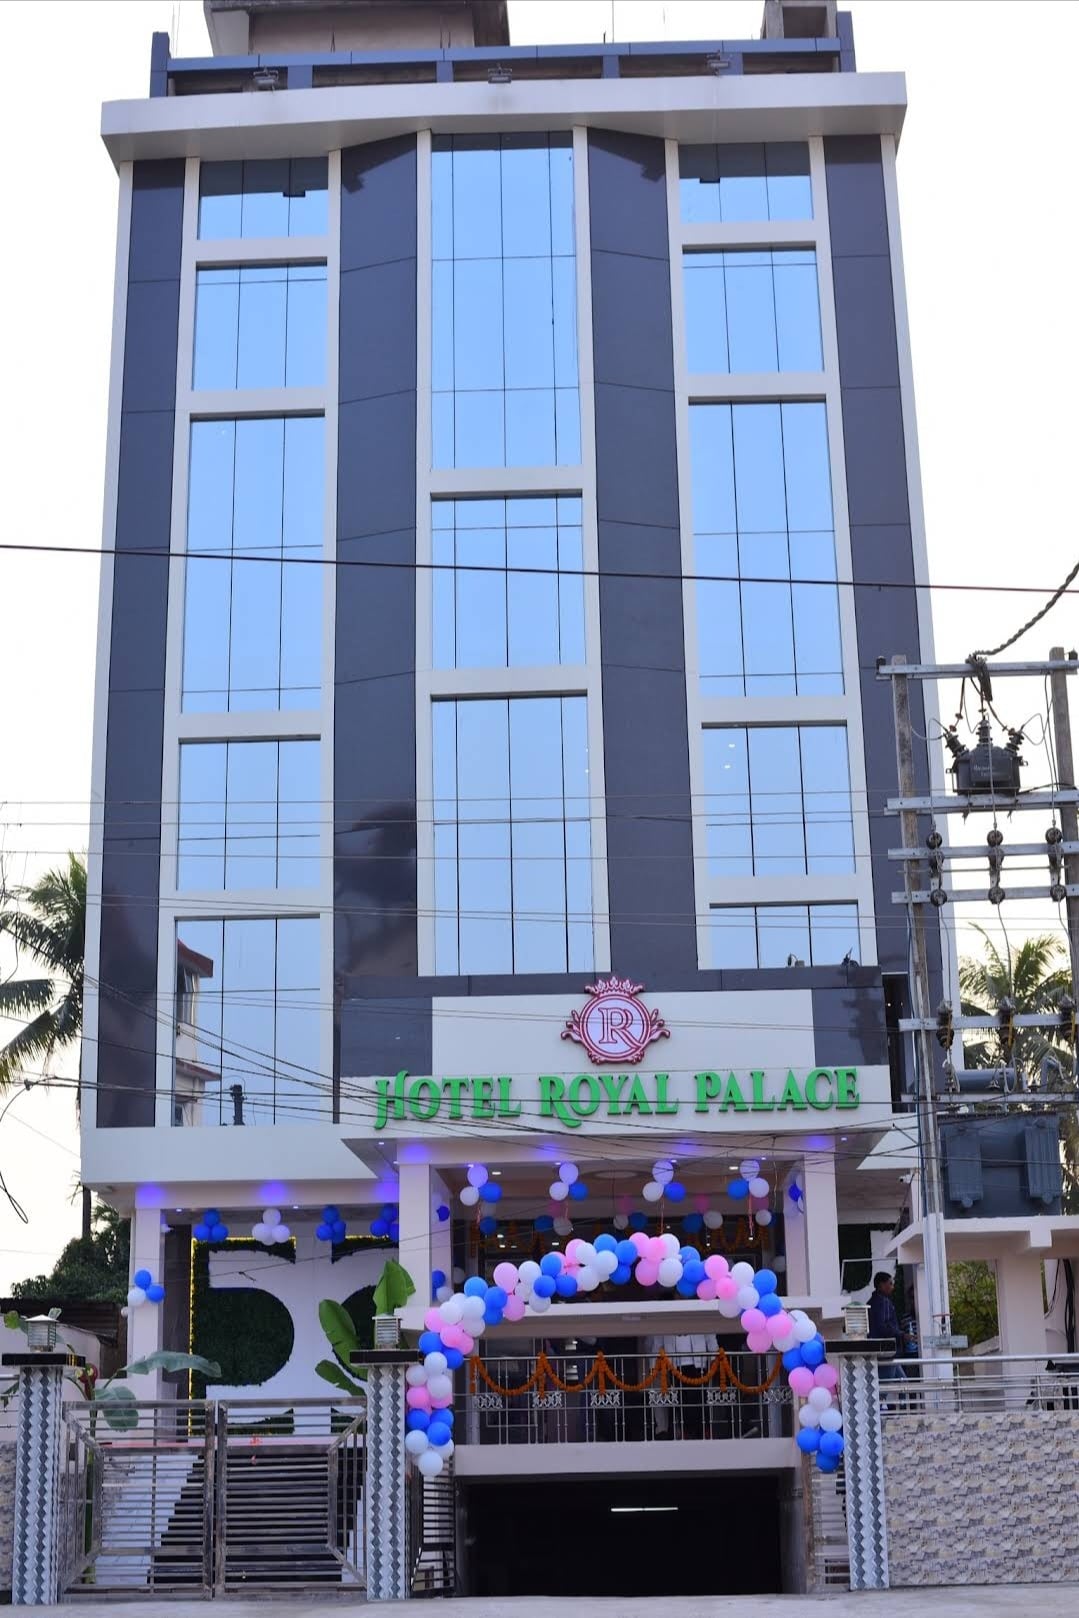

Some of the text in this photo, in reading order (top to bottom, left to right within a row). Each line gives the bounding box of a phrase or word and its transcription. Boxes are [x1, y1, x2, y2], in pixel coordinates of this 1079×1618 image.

[598, 1007, 639, 1048] R
[374, 1067, 860, 1130] HOTEL ROYAL PALACE
